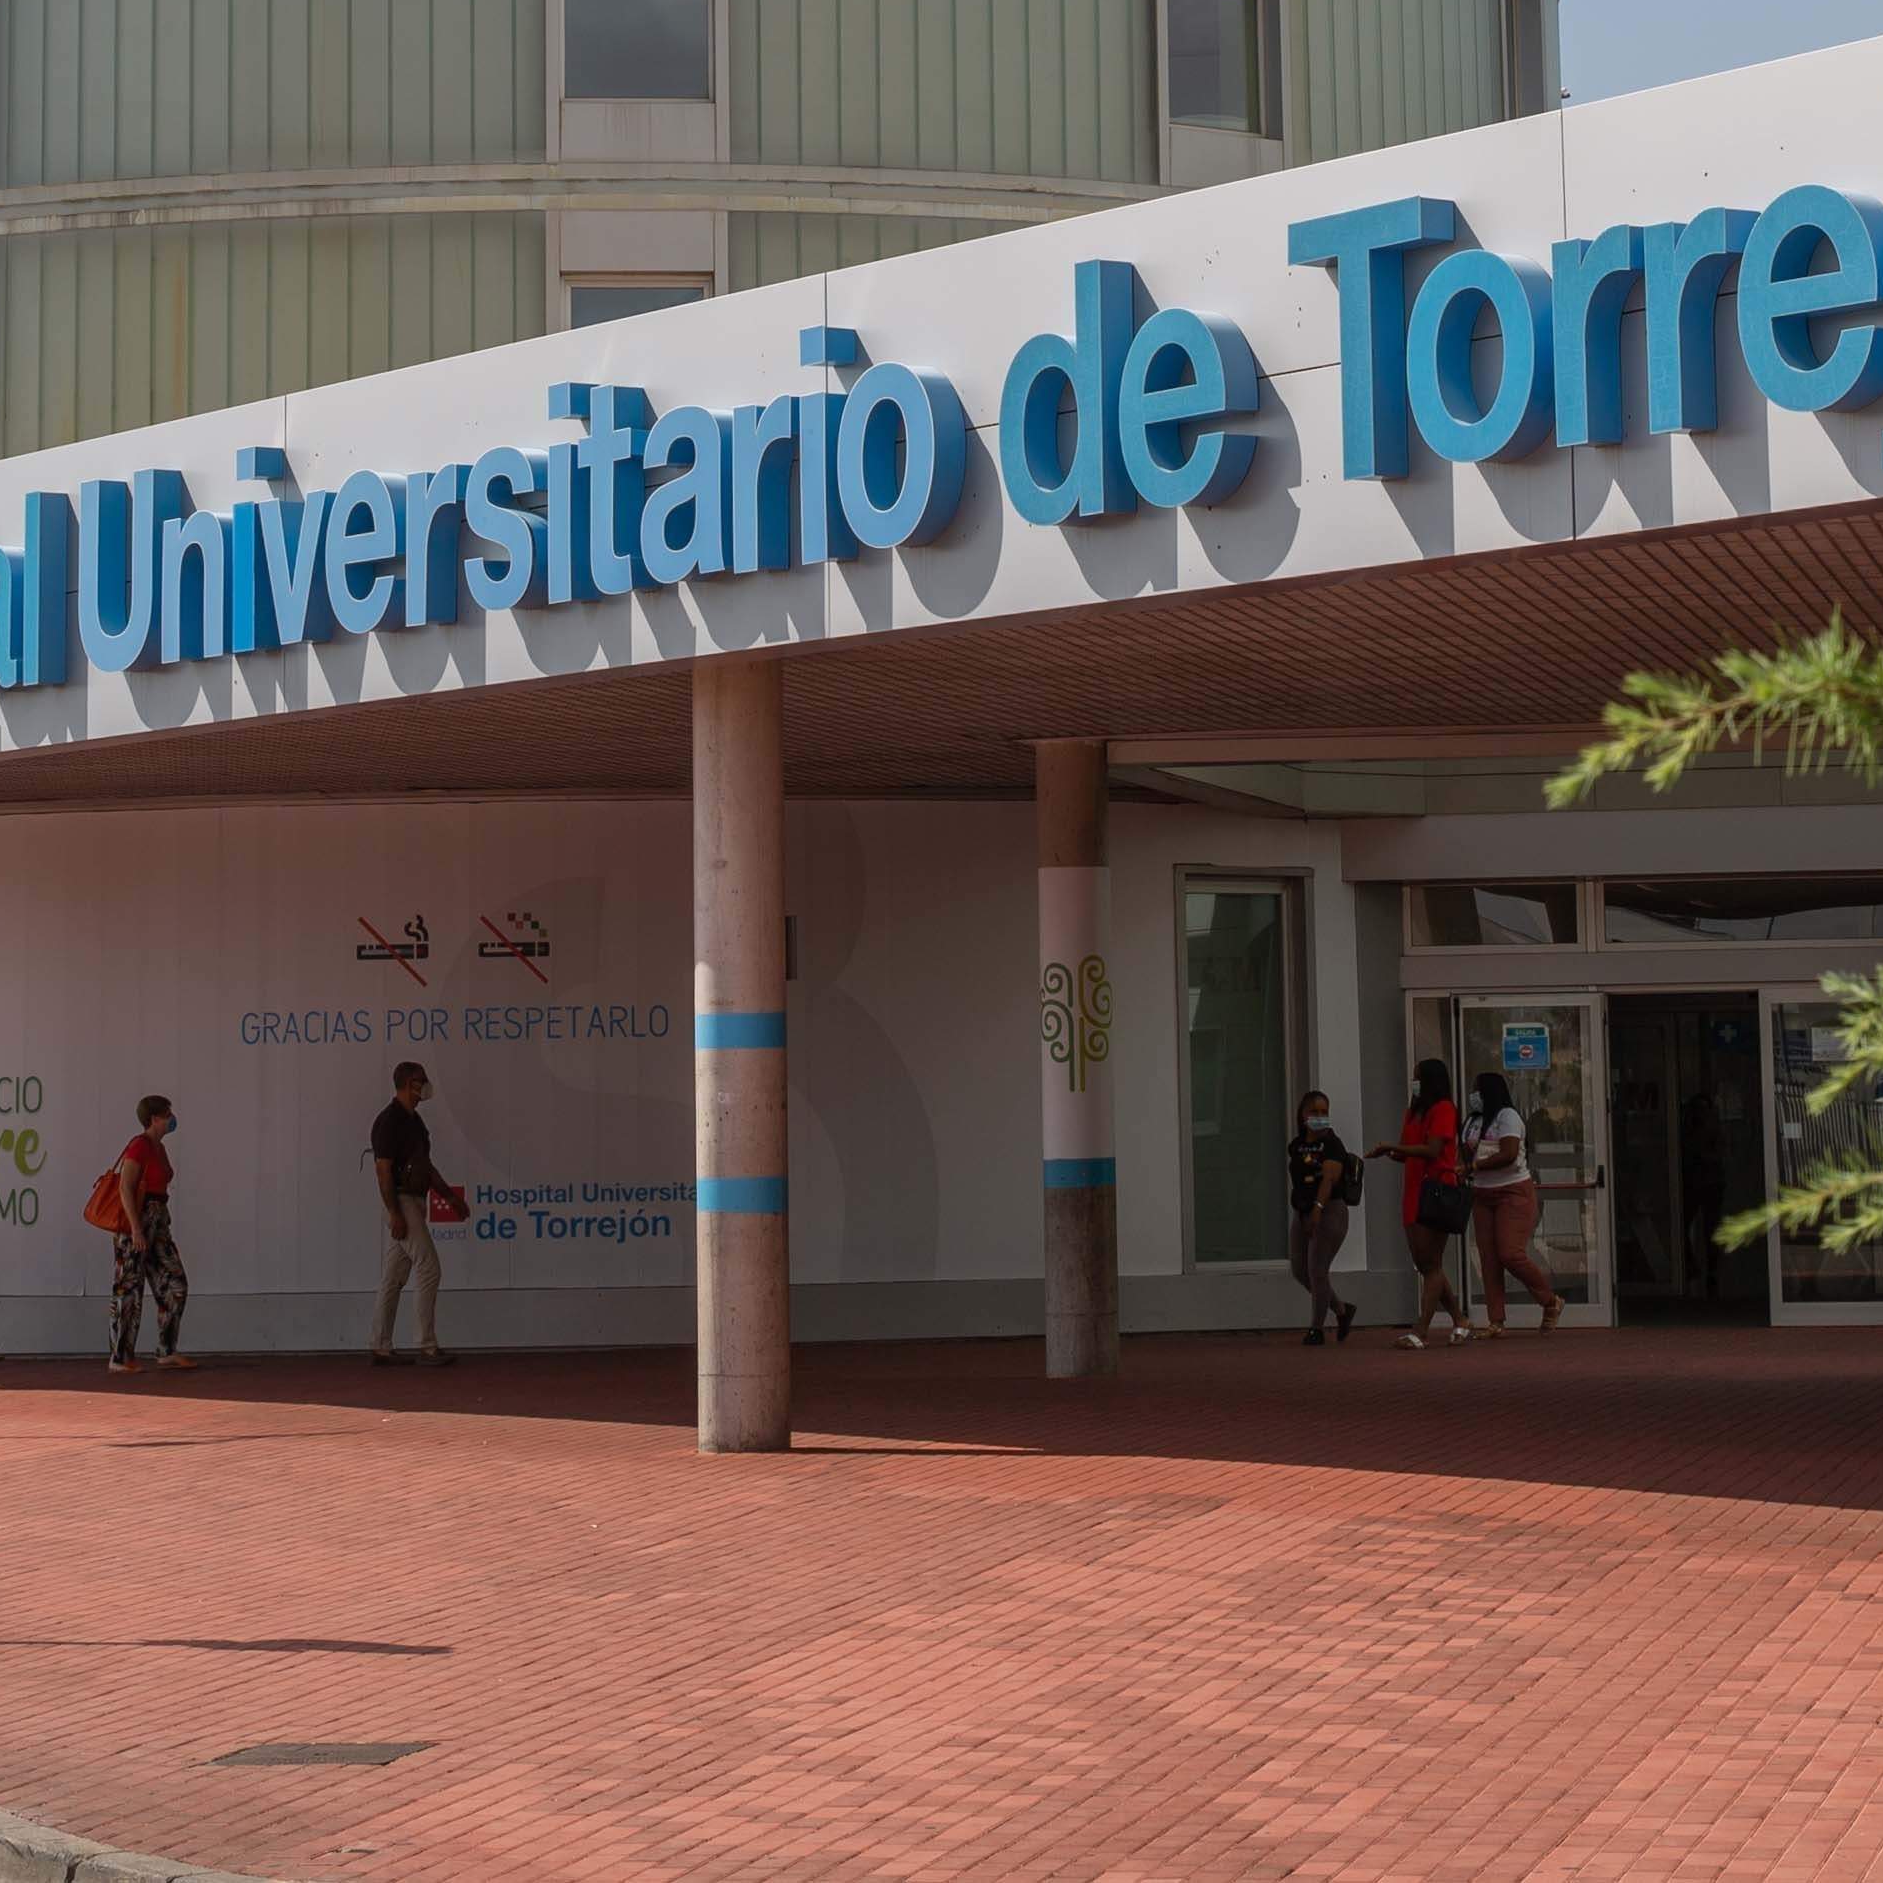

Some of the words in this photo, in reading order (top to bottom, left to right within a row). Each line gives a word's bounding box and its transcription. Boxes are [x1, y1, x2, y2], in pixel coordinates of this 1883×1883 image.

[79, 325, 965, 673] Universitario
[999, 259, 1259, 526] de
[240, 1011, 373, 1045] GRACIAS
[386, 1008, 449, 1042] POR
[464, 1004, 670, 1041] RESPETARLO
[476, 1183, 574, 1208] Hospital
[582, 1182, 696, 1203] Universita
[431, 1227, 467, 1240] adrid
[475, 1212, 517, 1240] de
[528, 1208, 671, 1244] Torrejón
